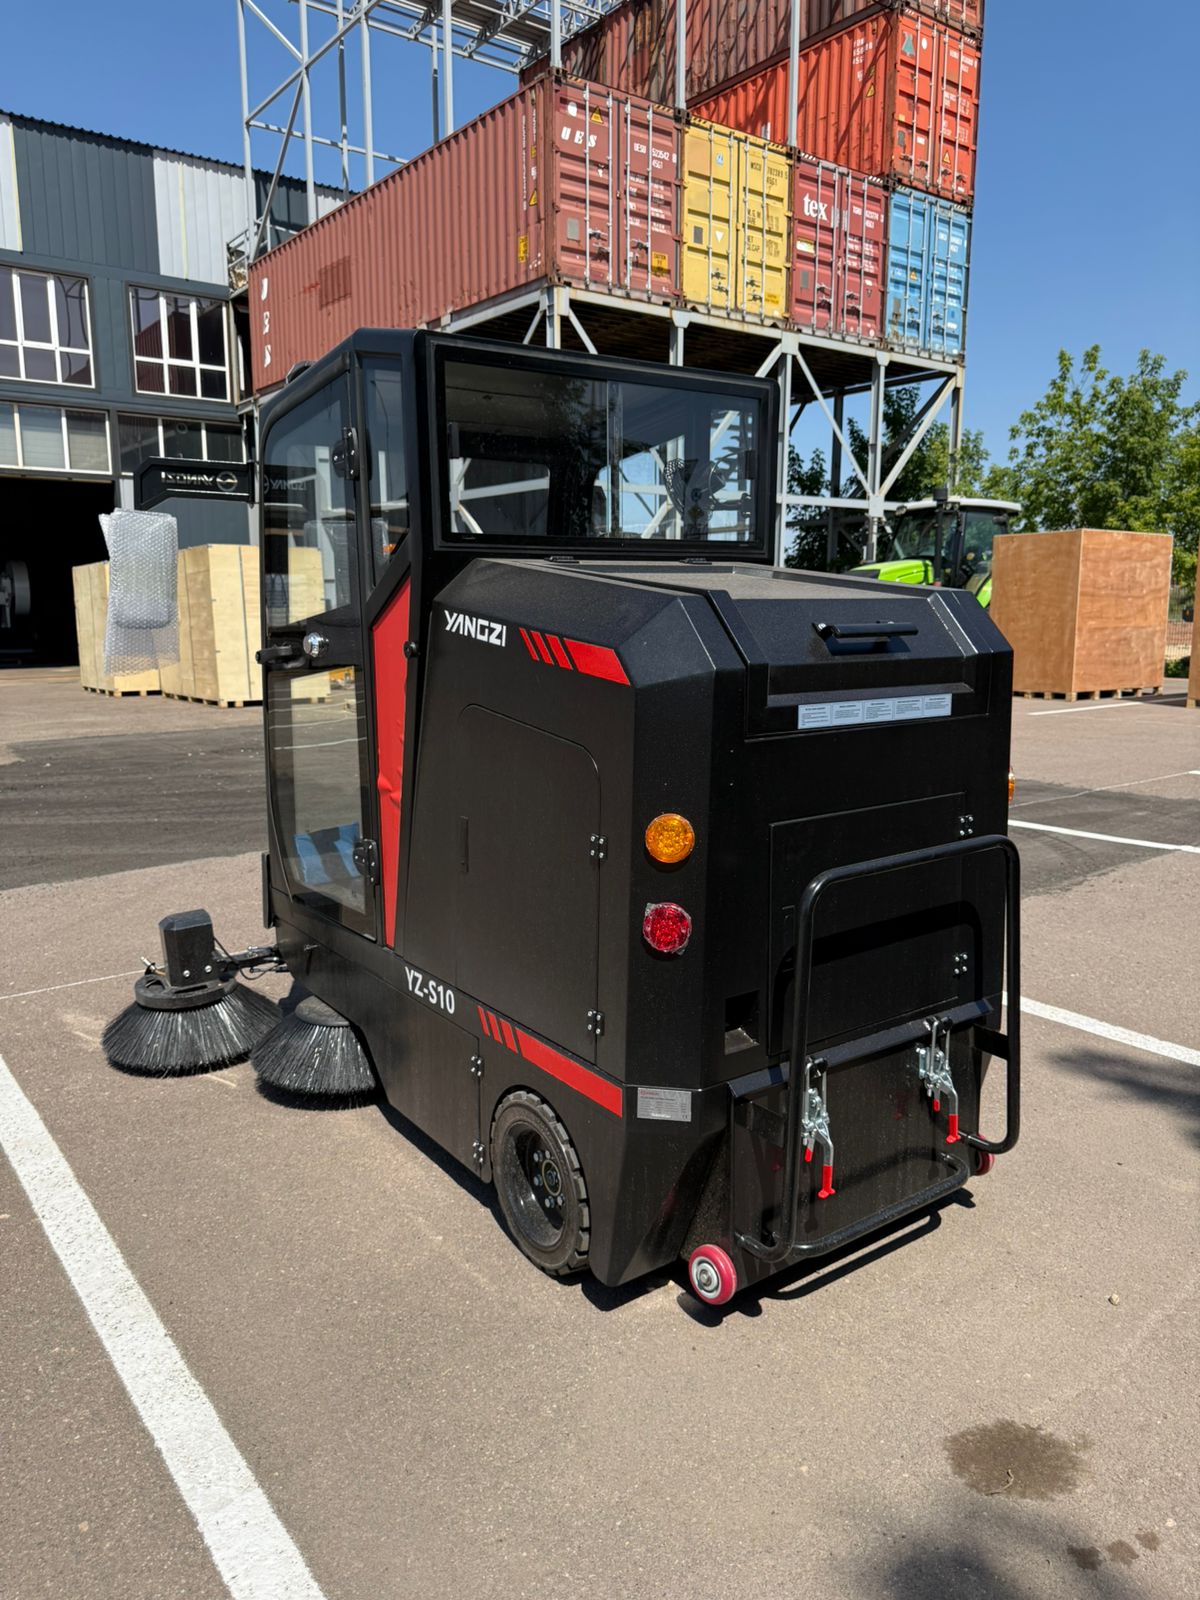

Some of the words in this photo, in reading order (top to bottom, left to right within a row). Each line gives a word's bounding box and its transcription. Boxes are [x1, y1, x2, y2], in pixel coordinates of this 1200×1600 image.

[803, 193, 828, 221] tex
[444, 610, 507, 647] YANGZI
[404, 966, 455, 1014] YZ-S10
